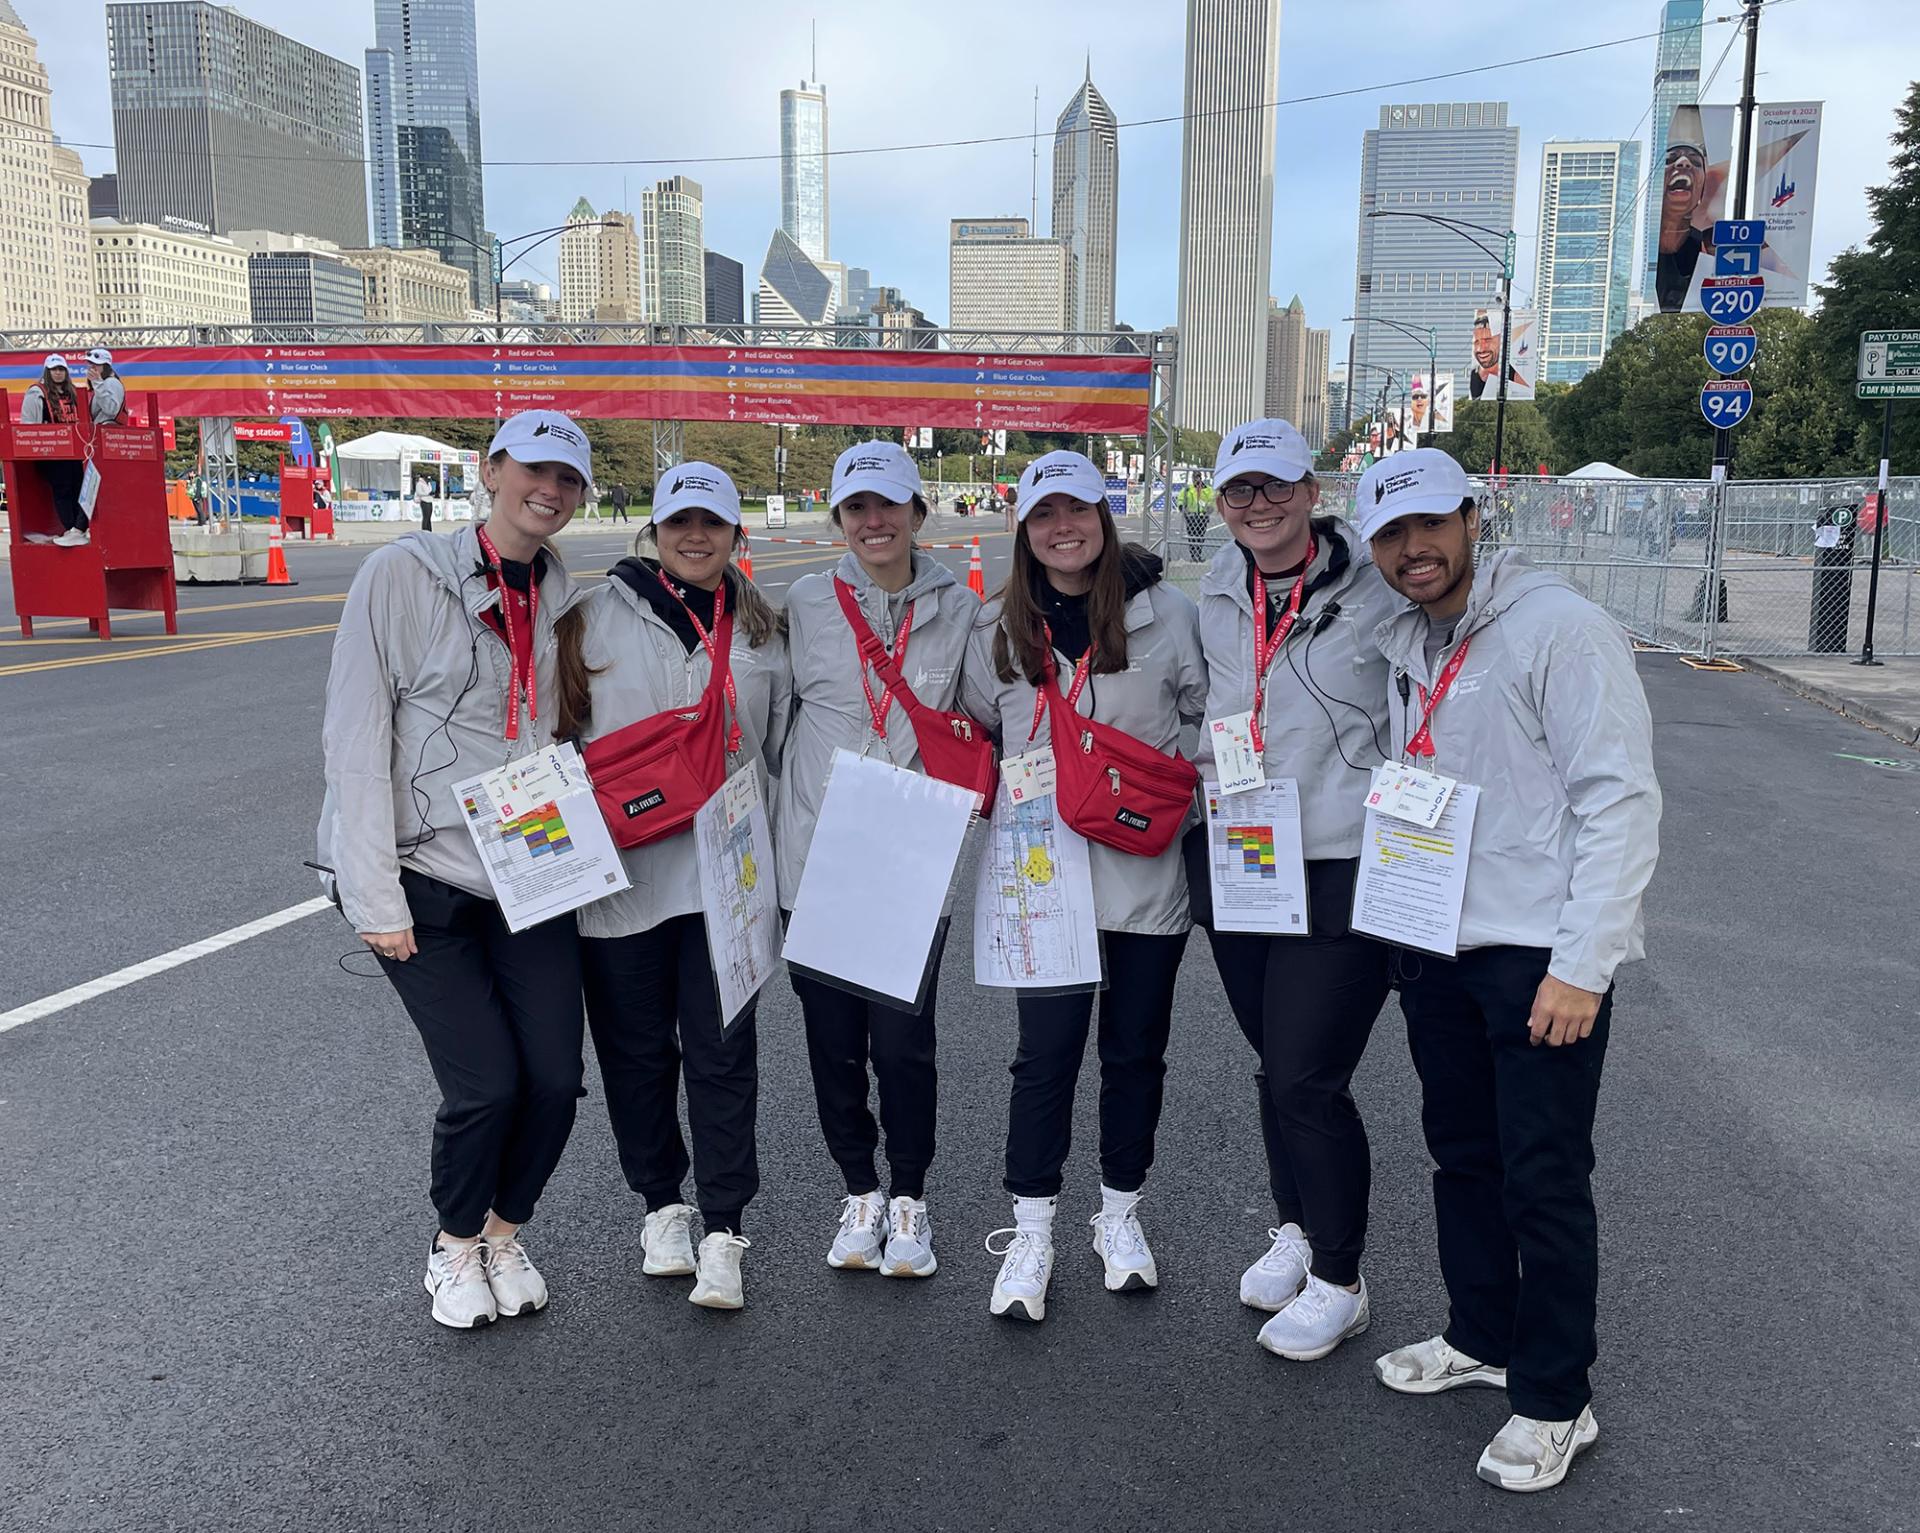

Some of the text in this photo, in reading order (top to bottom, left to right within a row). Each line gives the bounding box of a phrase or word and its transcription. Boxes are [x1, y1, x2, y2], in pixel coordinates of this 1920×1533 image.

[1763, 109, 1790, 117] October
[1799, 108, 1818, 116] 2023
[165, 215, 210, 232] MOTOROLA
[1730, 226, 1750, 240] TO
[1507, 237, 1515, 274] C541
[1710, 290, 1754, 314] 290
[1868, 334, 1885, 342] PAY
[1887, 333, 1899, 341] TO
[774, 352, 794, 360] Check
[1712, 342, 1748, 364] 90
[1007, 358, 1023, 366] Gear
[744, 366, 759, 374] Blue
[776, 367, 795, 375] Check
[784, 382, 804, 390] Check
[1861, 386, 1866, 394] 7
[1866, 386, 1879, 394] DAY
[1880, 386, 1895, 394] PAID
[1017, 389, 1033, 397] Gear
[1708, 395, 1743, 418] 94
[1052, 422, 1070, 430] Party
[255, 427, 283, 437] station
[1838, 511, 1848, 523] P
[1273, 617, 1290, 646] AMERICA
[1074, 669, 1087, 697] AMERICA
[549, 754, 569, 787] 2023
[1224, 776, 1256, 789] 2023
[1014, 789, 1022, 798] 5
[1426, 787, 1447, 821] 2023
[504, 805, 511, 815] 5
